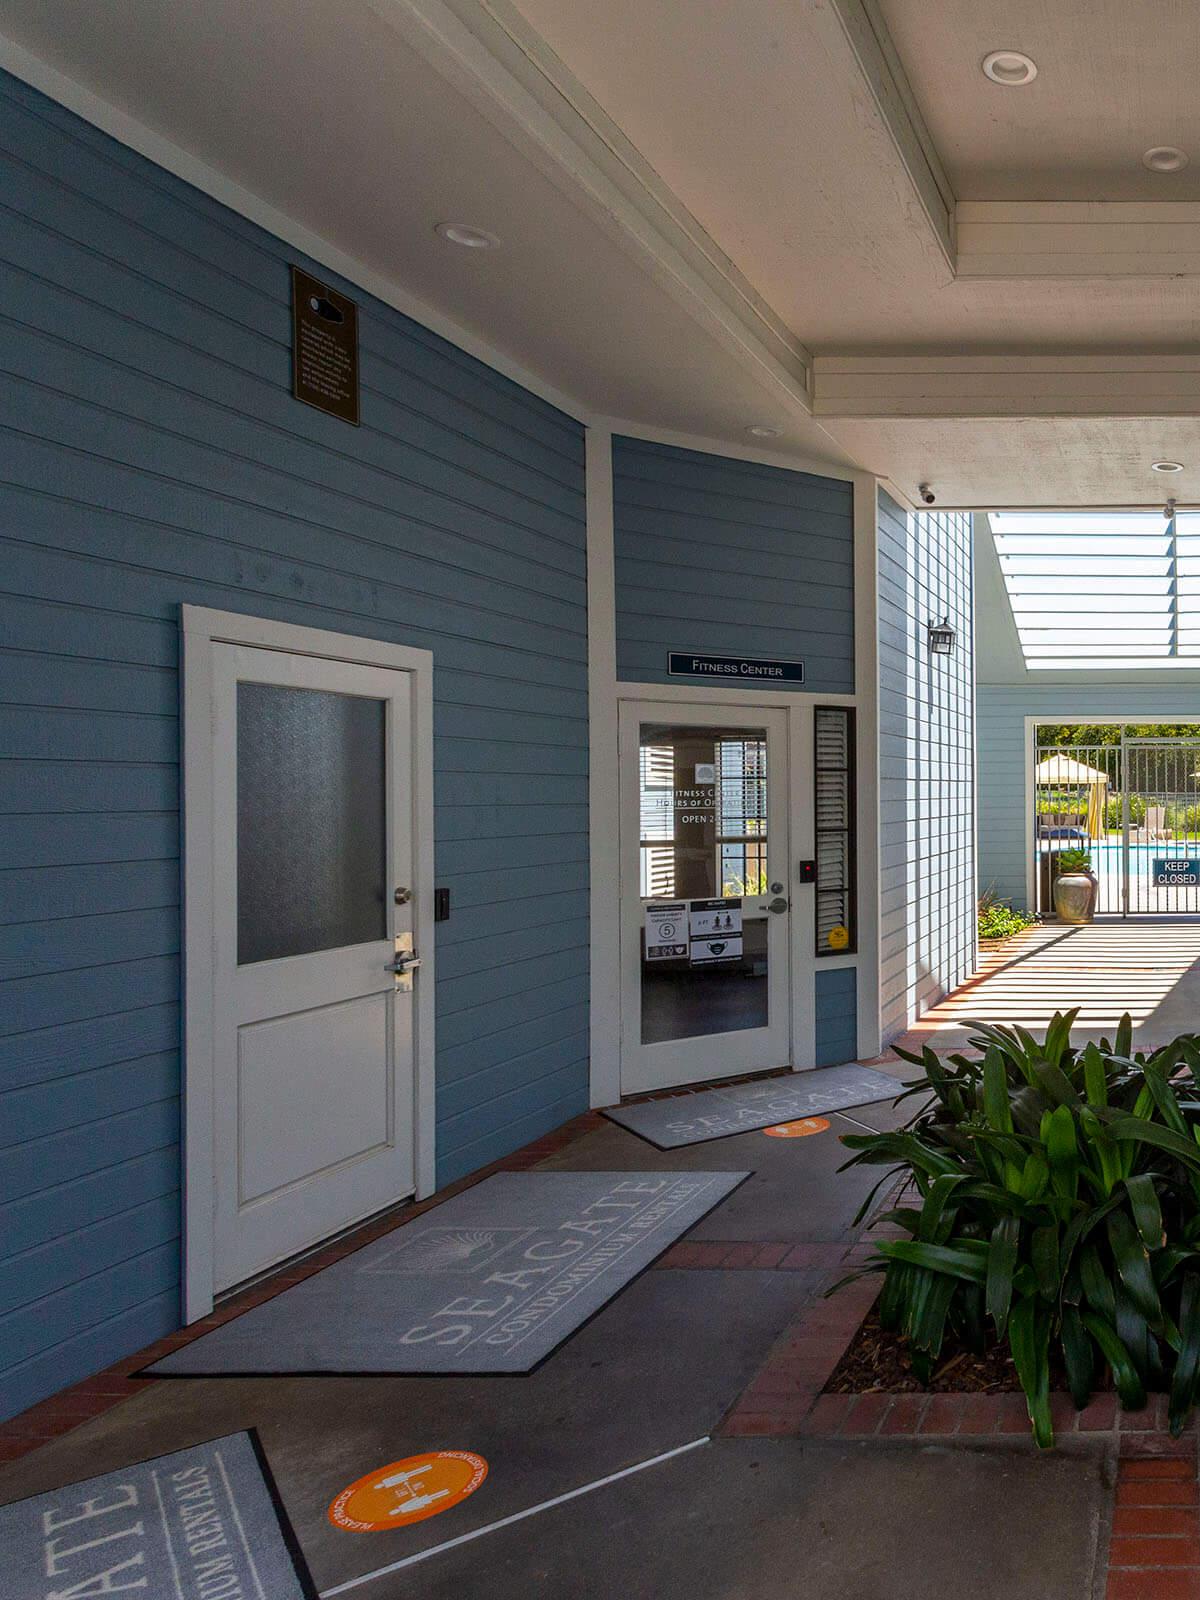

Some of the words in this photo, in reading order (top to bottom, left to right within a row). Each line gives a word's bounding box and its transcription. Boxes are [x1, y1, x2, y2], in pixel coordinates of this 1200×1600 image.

[692, 659, 738, 674] FITNESS
[740, 662, 783, 677] CENTER
[671, 788, 705, 797] ITNESS
[682, 815, 707, 824] OPEN
[1164, 861, 1190, 871] KEEP
[1158, 873, 1197, 884] CLOSED
[663, 924, 671, 937] 5
[400, 1179, 667, 1346] SEAGATE
[486, 1232, 636, 1345] CONDOMINIUM
[629, 1183, 700, 1230] RENTALS
[171, 1465, 228, 1557] RENTALS
